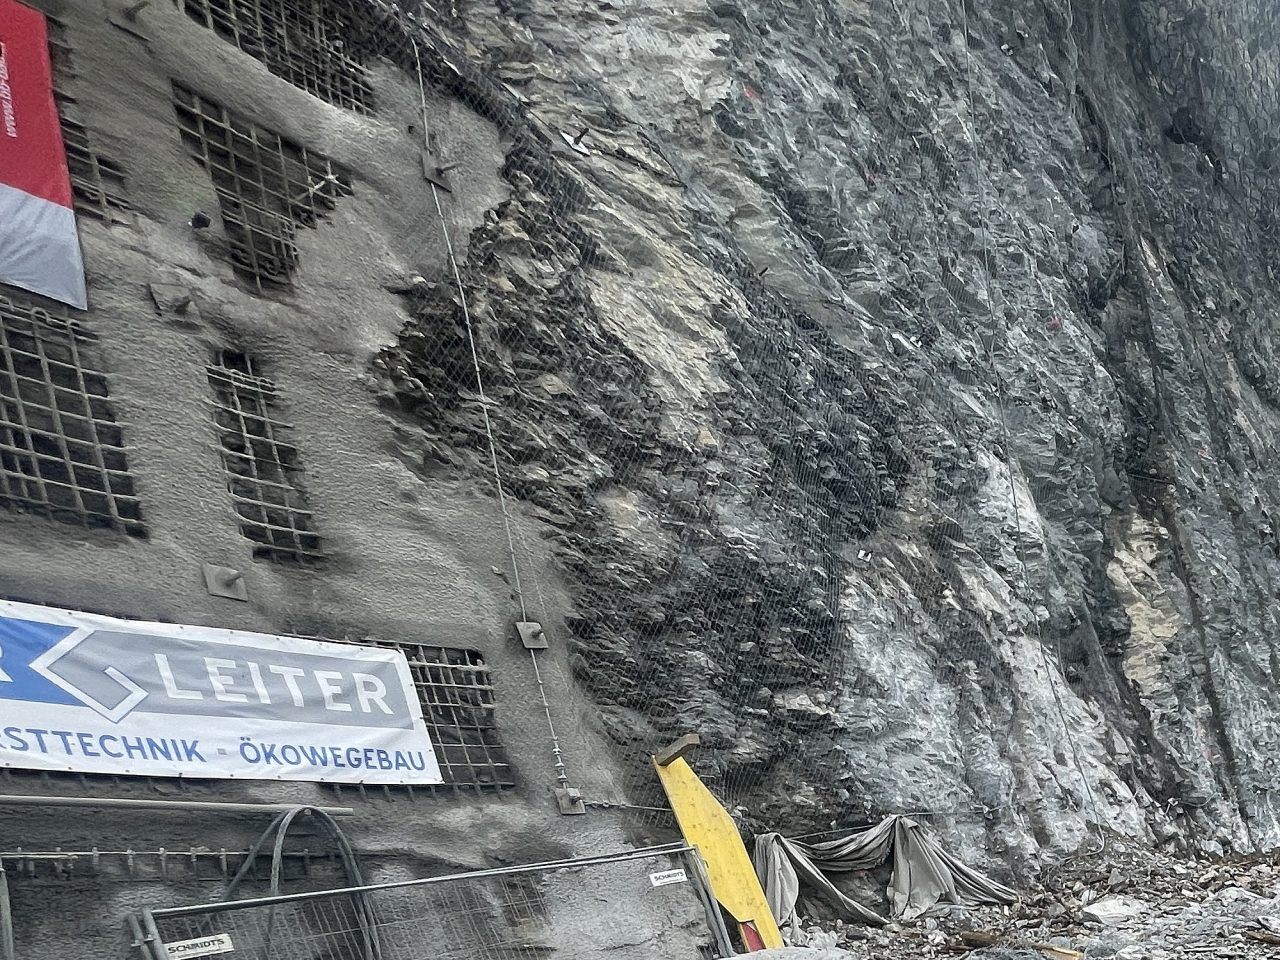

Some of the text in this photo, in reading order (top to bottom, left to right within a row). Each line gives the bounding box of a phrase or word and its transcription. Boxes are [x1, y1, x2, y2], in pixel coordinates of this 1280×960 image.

[154, 653, 394, 715] LEITER
[0, 726, 426, 771] STTECHNIK ÖKOWEGEBAU
[168, 938, 225, 954] SCHMIDTS
